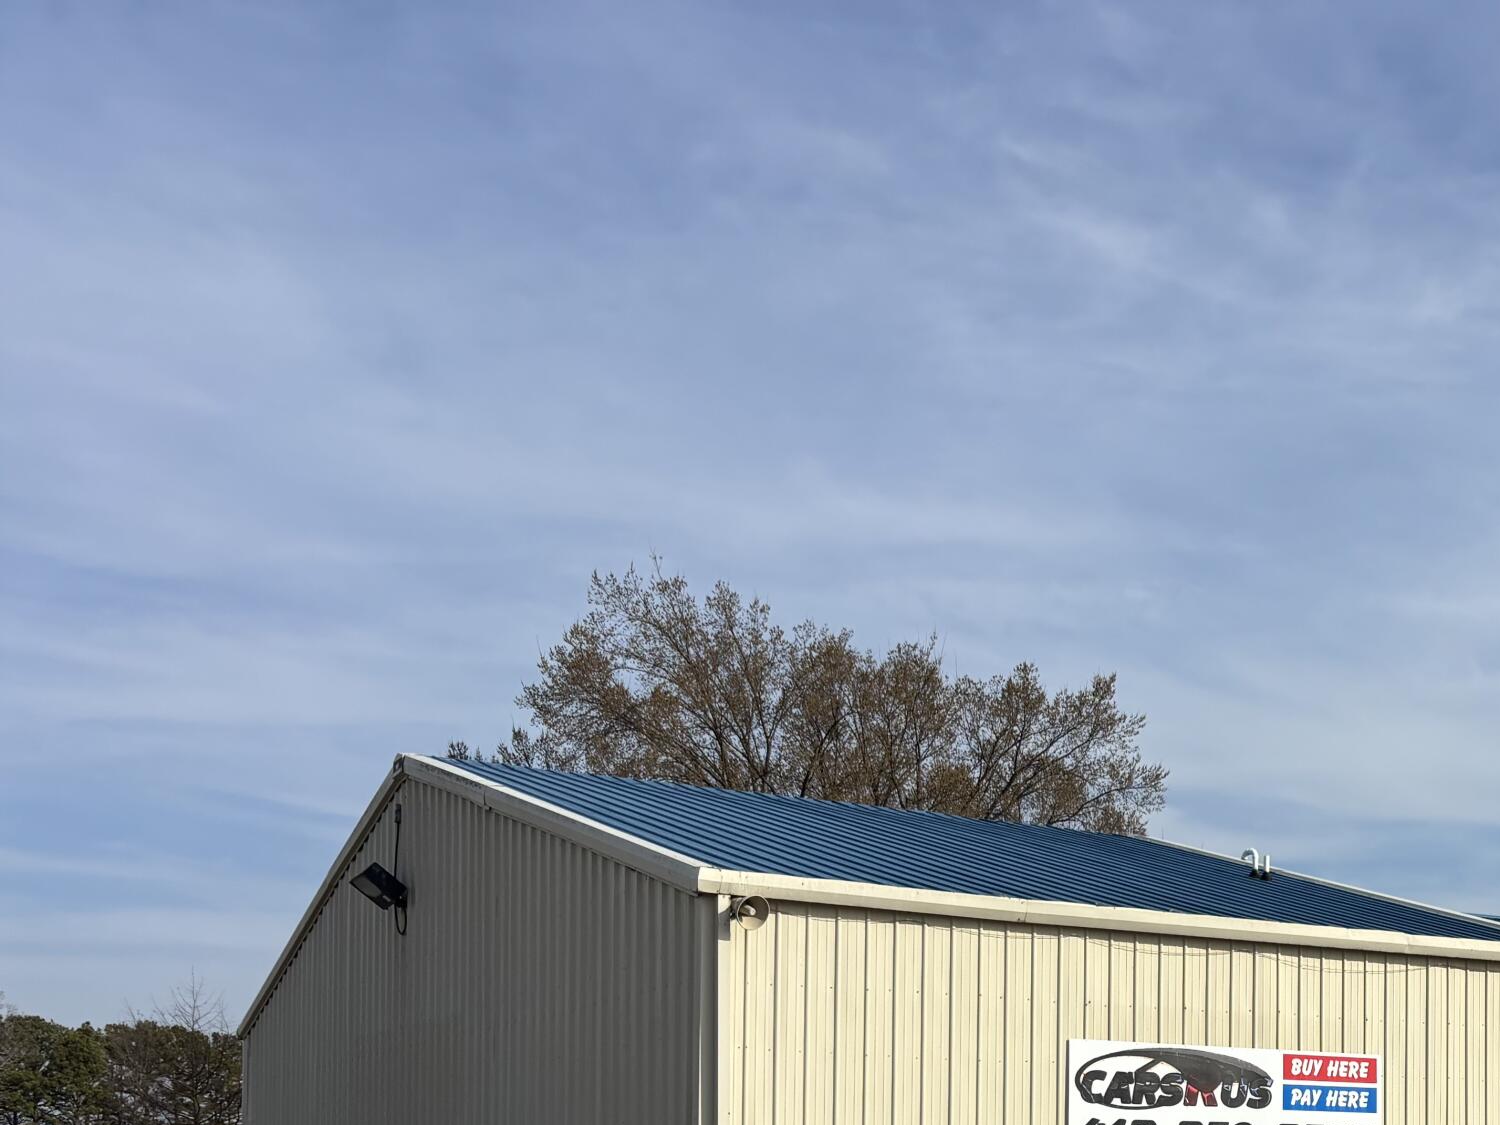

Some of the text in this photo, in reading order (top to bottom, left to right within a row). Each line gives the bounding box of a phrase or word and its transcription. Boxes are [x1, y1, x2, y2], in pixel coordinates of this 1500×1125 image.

[1291, 1058, 1370, 1080] BUY HERE
[1291, 1088, 1370, 1109] PAY HERE
